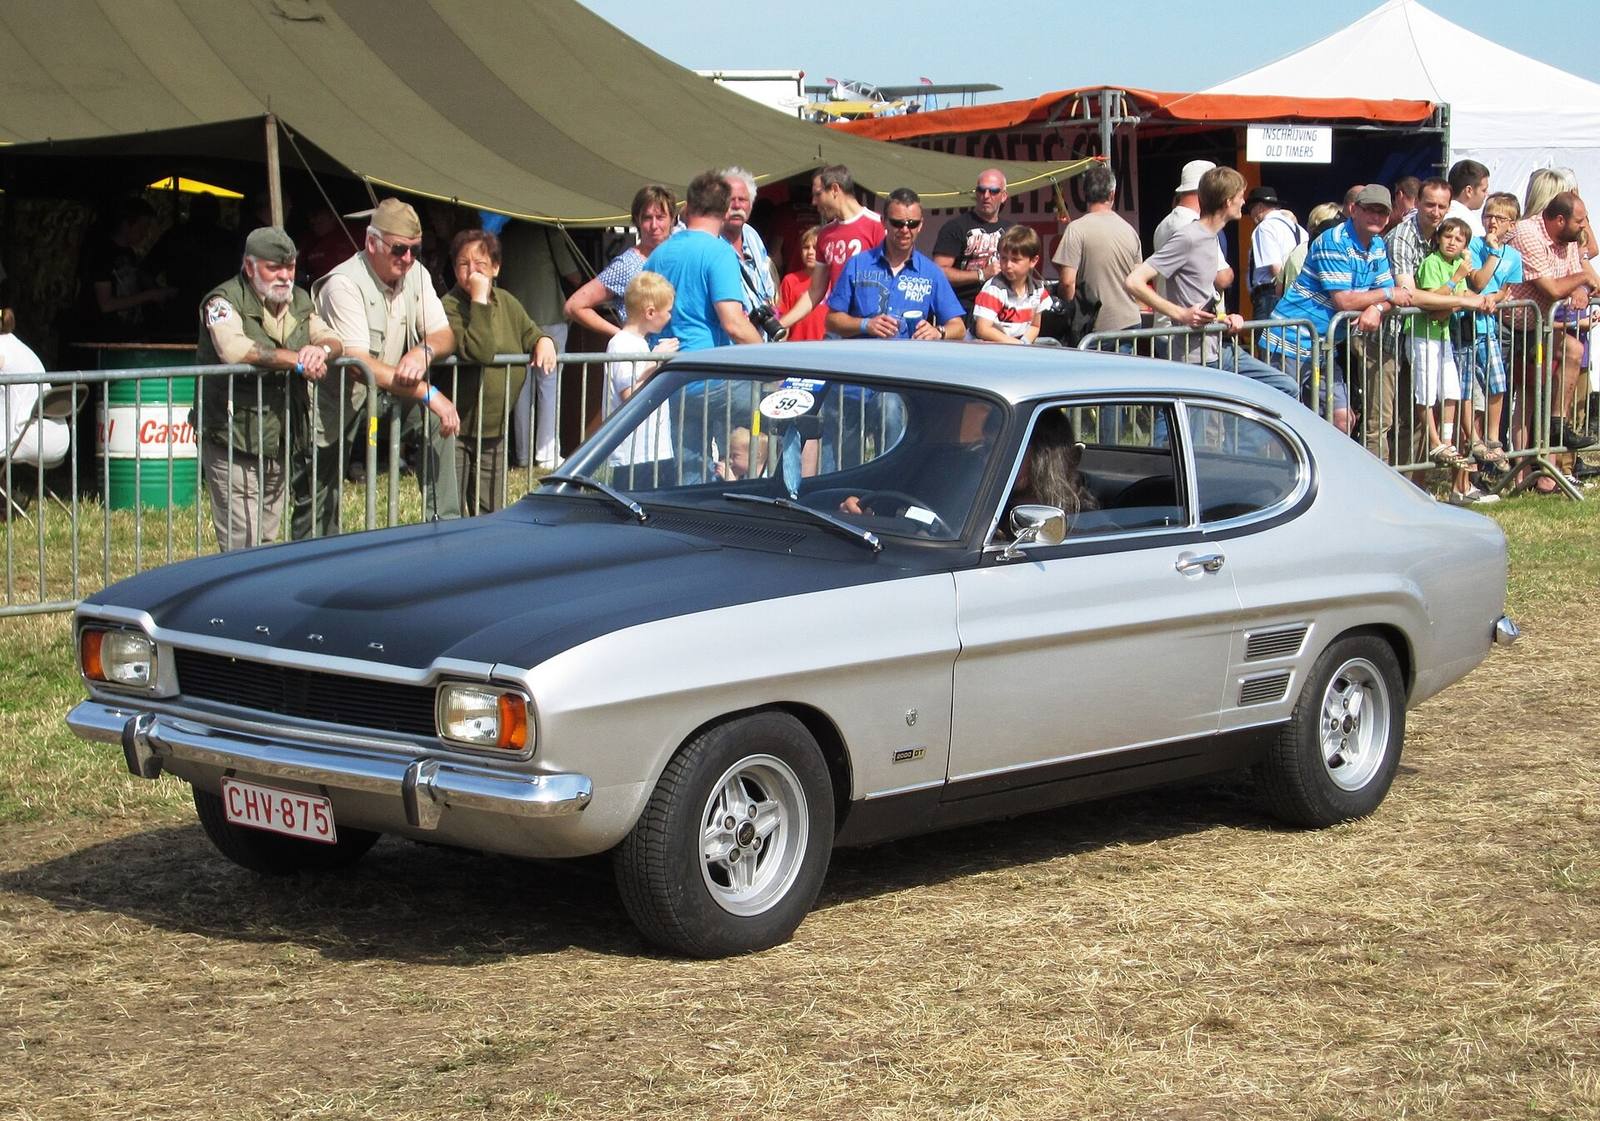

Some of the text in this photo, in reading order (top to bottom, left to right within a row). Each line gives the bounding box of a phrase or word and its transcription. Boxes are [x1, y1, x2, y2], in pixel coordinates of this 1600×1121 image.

[1265, 145, 1314, 158] OLD TIMERS
[898, 281, 932, 295] GRAND
[905, 290, 924, 303] PRIX
[775, 397, 798, 411] 59
[228, 786, 329, 836] CHV-875
